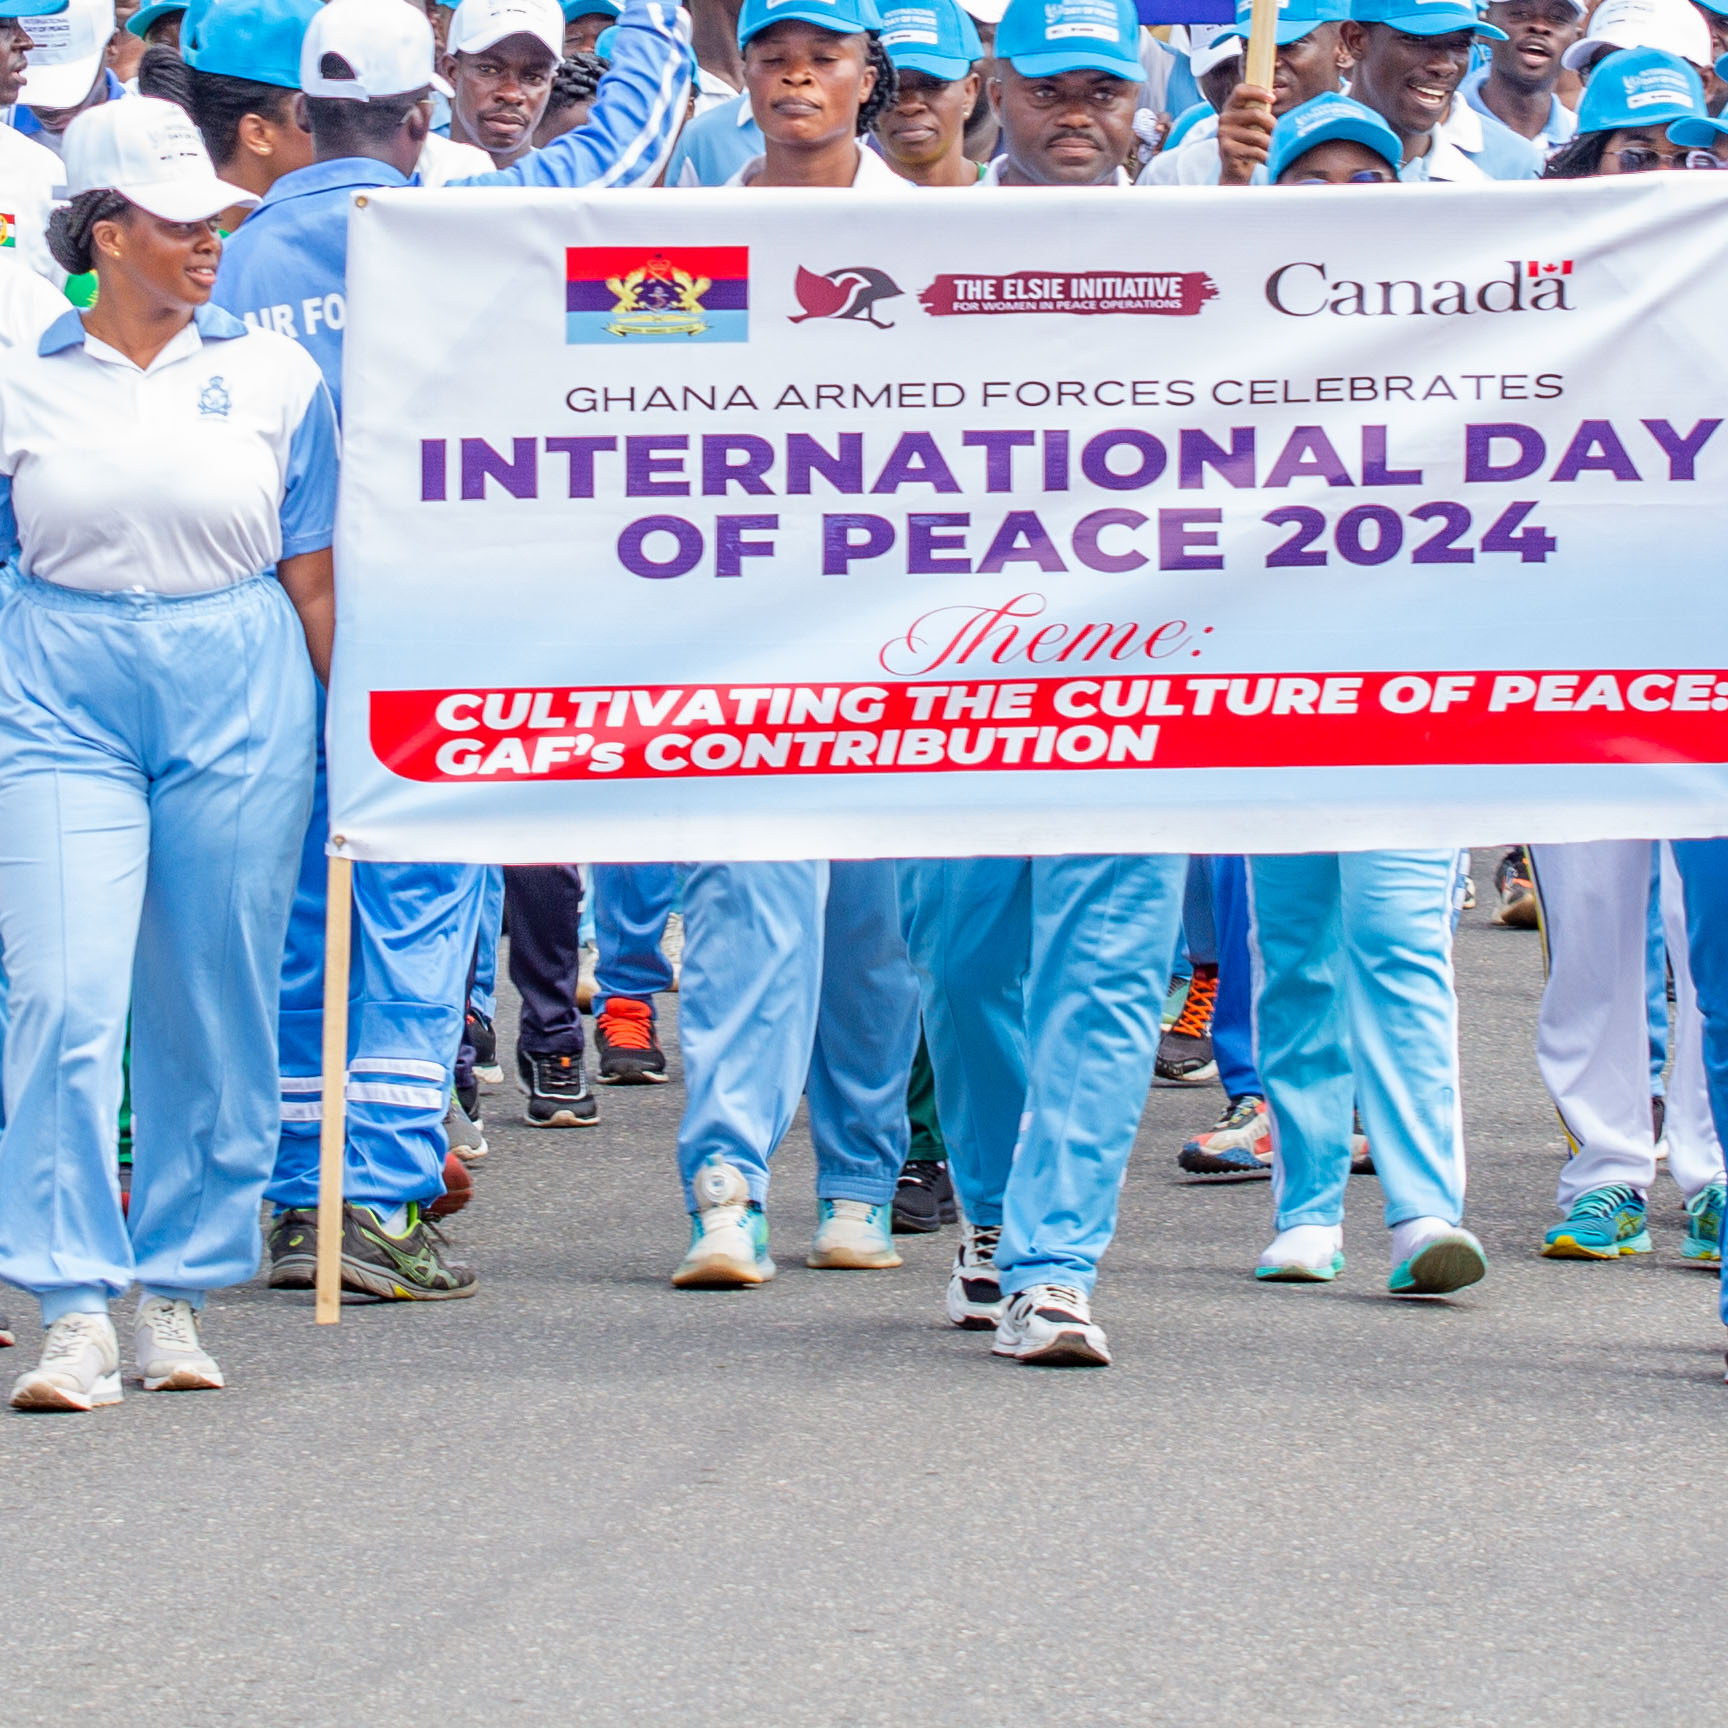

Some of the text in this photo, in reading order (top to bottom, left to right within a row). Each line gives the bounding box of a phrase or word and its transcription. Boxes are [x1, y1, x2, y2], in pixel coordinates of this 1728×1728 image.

[953, 277, 1183, 300] THE ELSIE INITIATIVE
[953, 299, 1183, 312] FOR WOMEN IN PEACE OPERATIONS
[1265, 260, 1577, 318] Canada
[565, 373, 1564, 413] GHANA ARMED FORCES CELEBRATES
[420, 417, 1725, 501] INTERNATIONAL DAY
[617, 500, 1558, 580] OF PEACE 2024
[879, 592, 1215, 676] Theme:
[434, 686, 890, 733] CULTIVATING
[904, 683, 1037, 721] THE
[1053, 677, 1366, 718] CULTURE
[1377, 675, 1475, 714] OF
[644, 723, 1160, 772] CONTRIBUTION
